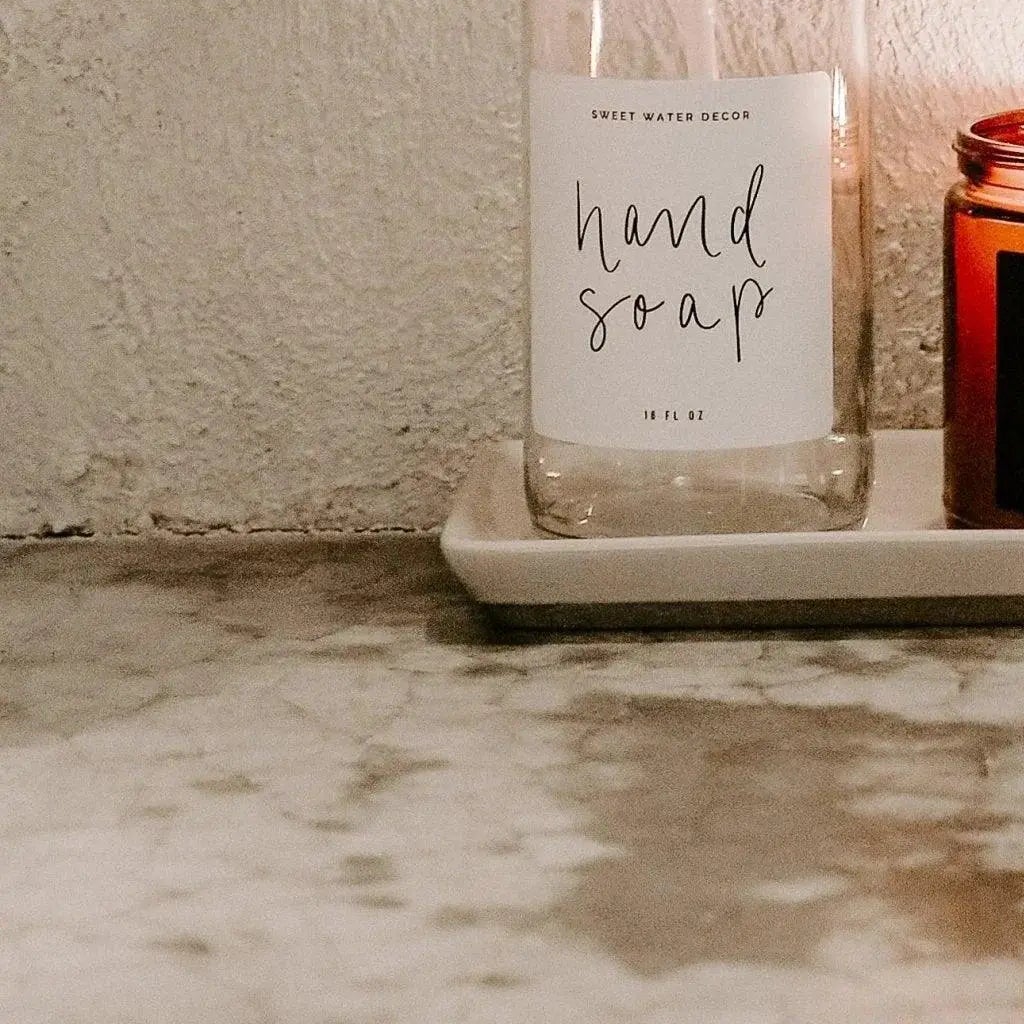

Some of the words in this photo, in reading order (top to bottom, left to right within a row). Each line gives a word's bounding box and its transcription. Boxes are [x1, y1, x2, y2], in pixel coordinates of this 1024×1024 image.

[592, 109, 636, 122] SWEET
[643, 112, 694, 123] WATER
[701, 111, 751, 122] DECOR
[577, 163, 767, 273] hand
[579, 278, 774, 363] soap
[665, 410, 680, 421] FL
[688, 410, 705, 421] OZ
